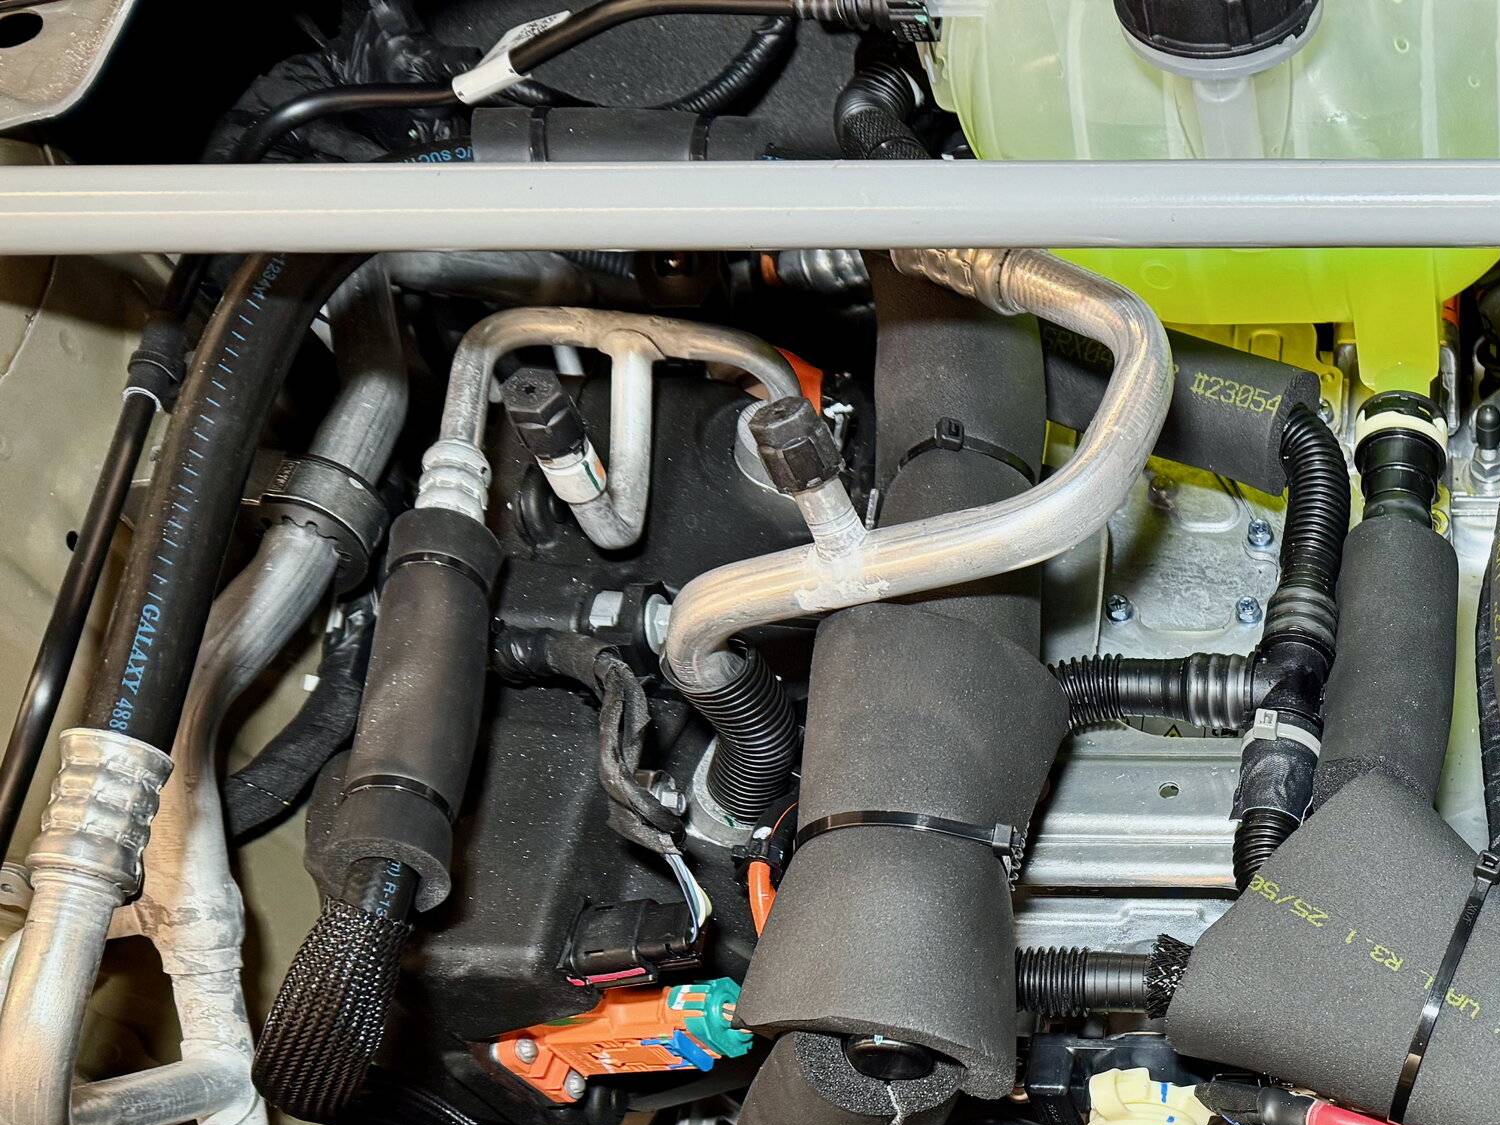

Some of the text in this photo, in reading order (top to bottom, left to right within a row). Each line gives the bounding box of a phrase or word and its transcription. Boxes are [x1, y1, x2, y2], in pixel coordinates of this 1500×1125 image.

[1190, 371, 1284, 414] #23054
[108, 601, 165, 738] GALAXY 488
[1419, 968, 1482, 1020] WAL
